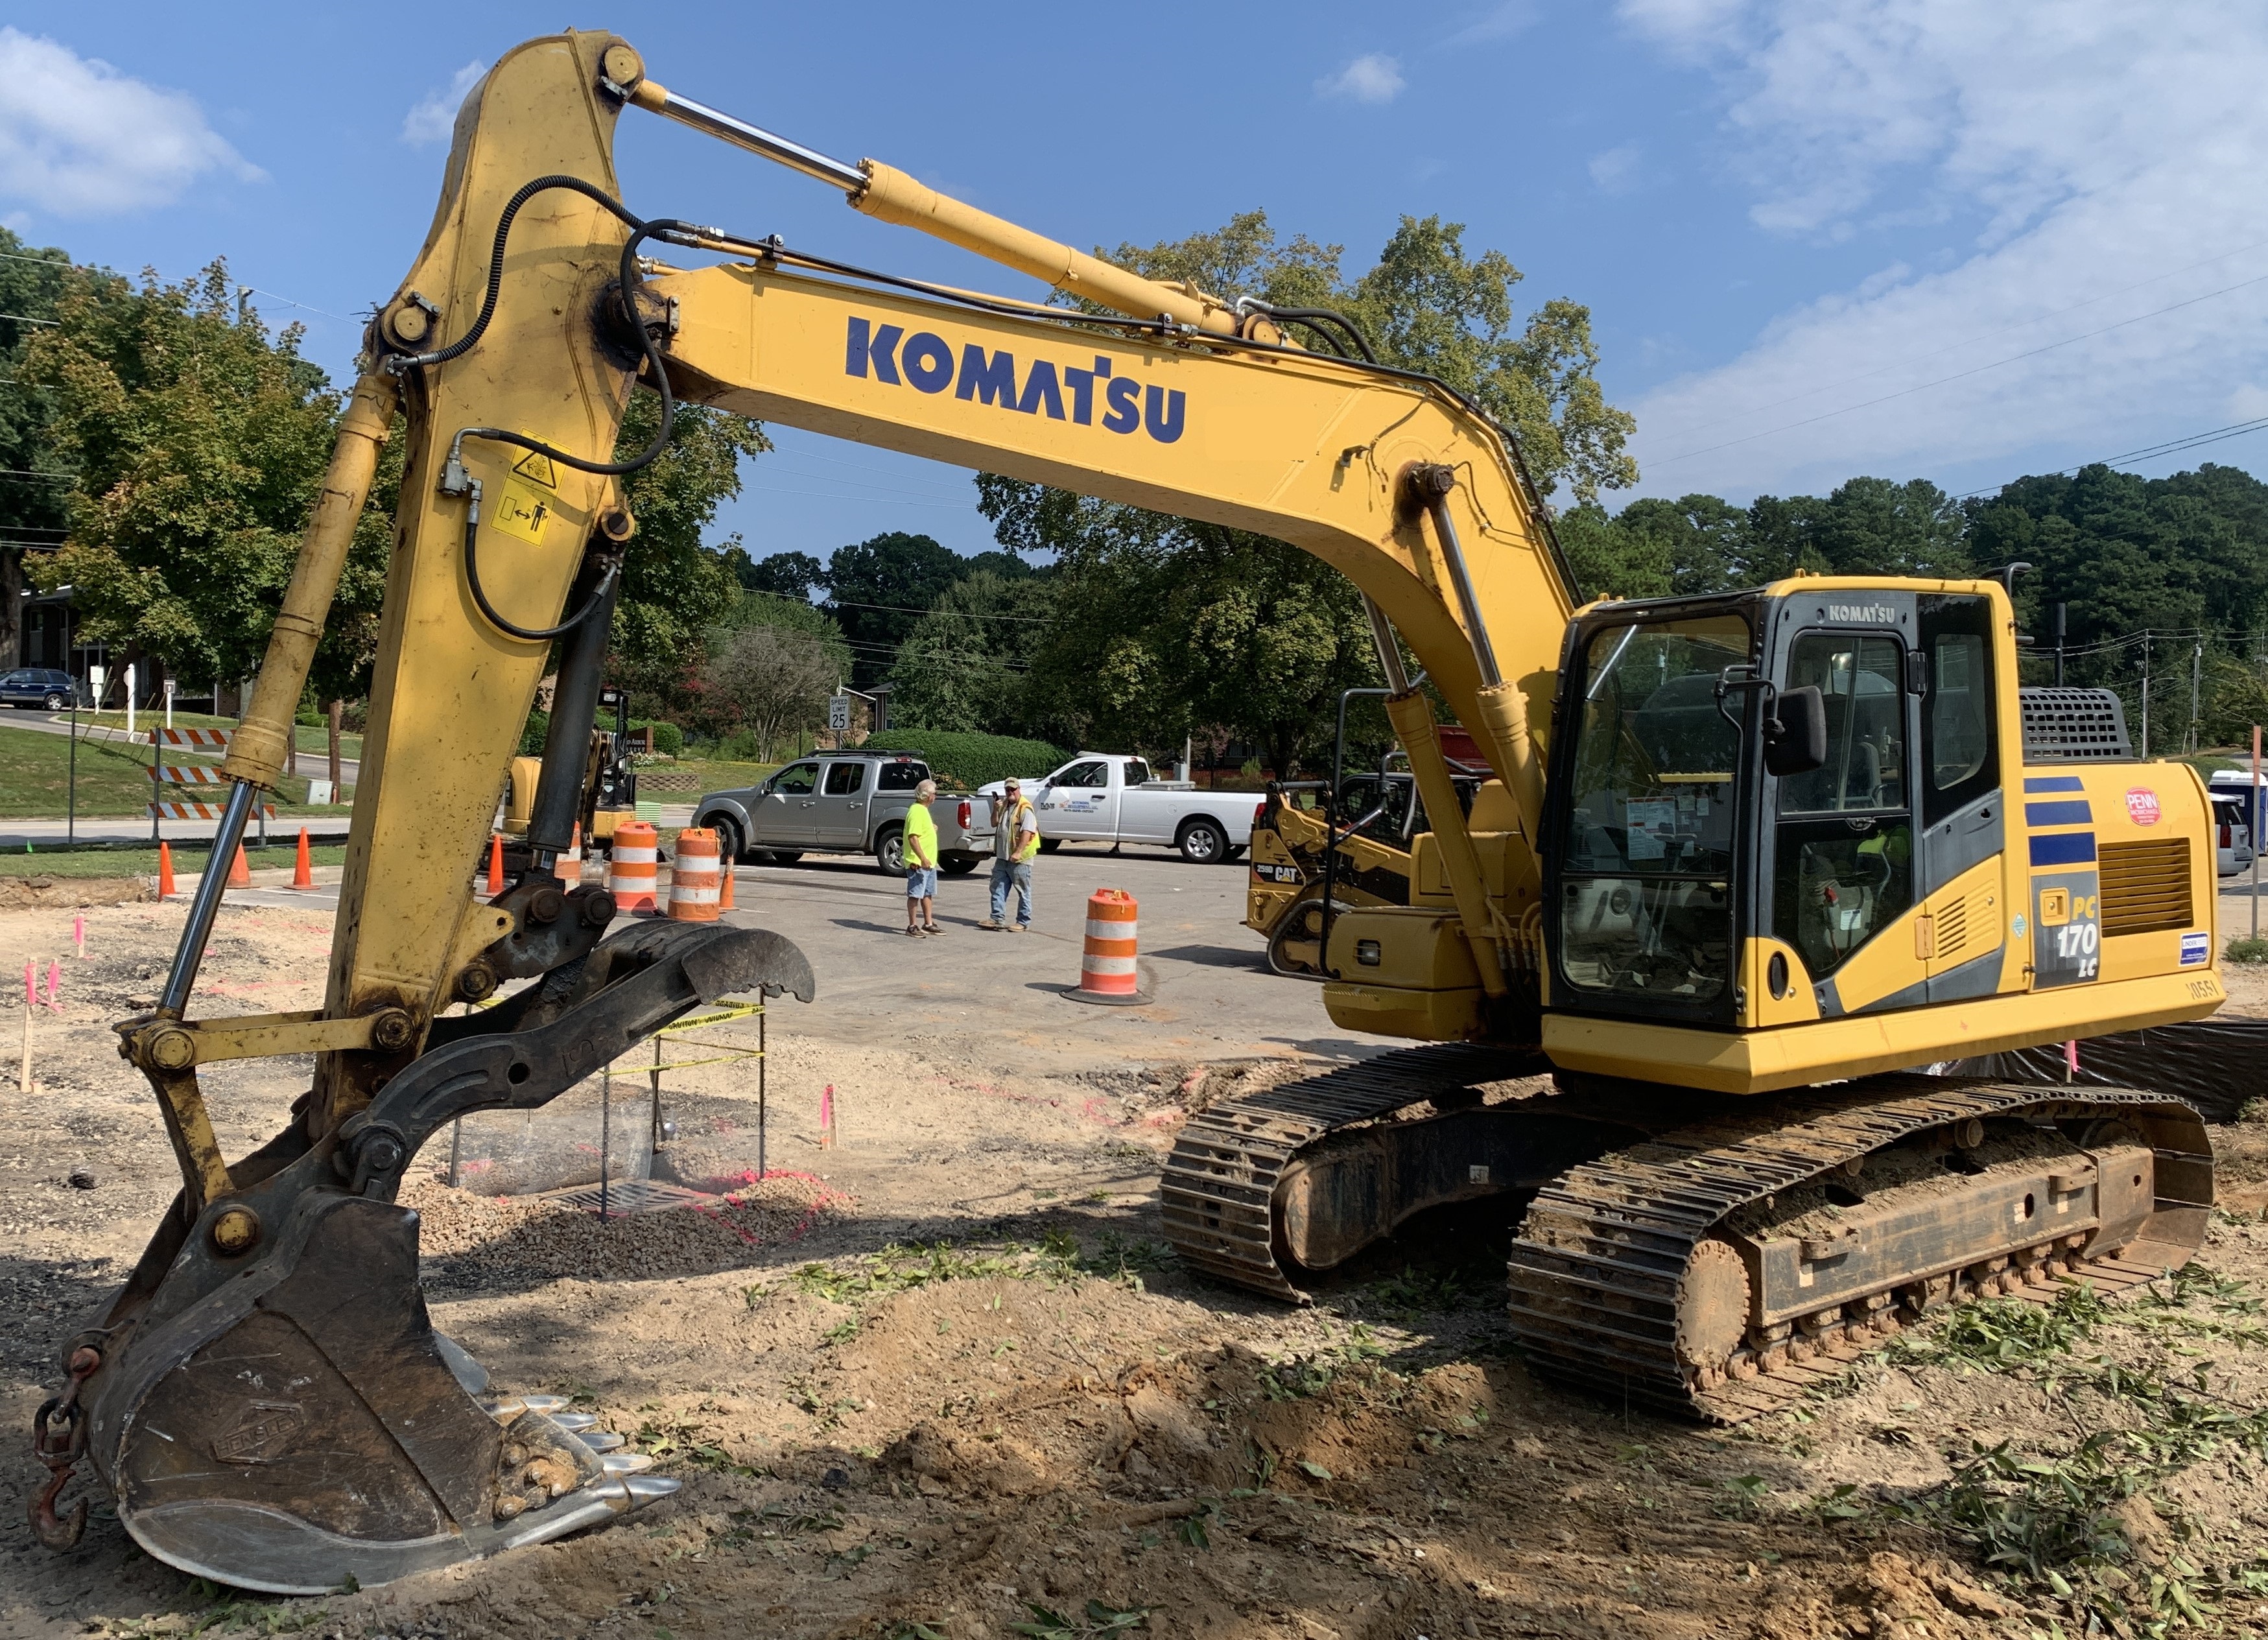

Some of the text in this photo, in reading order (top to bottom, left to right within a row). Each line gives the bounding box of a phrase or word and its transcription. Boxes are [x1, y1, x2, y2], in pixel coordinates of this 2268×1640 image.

[845, 316, 1185, 444] KOMATSU
[1829, 603, 1895, 623] KOMATSU
[833, 714, 845, 728] 25
[2127, 793, 2158, 811] PENN
[1275, 866, 1297, 883] CAT
[2072, 895, 2097, 921] PC
[2057, 923, 2097, 957] 170
[2078, 957, 2098, 978] LC
